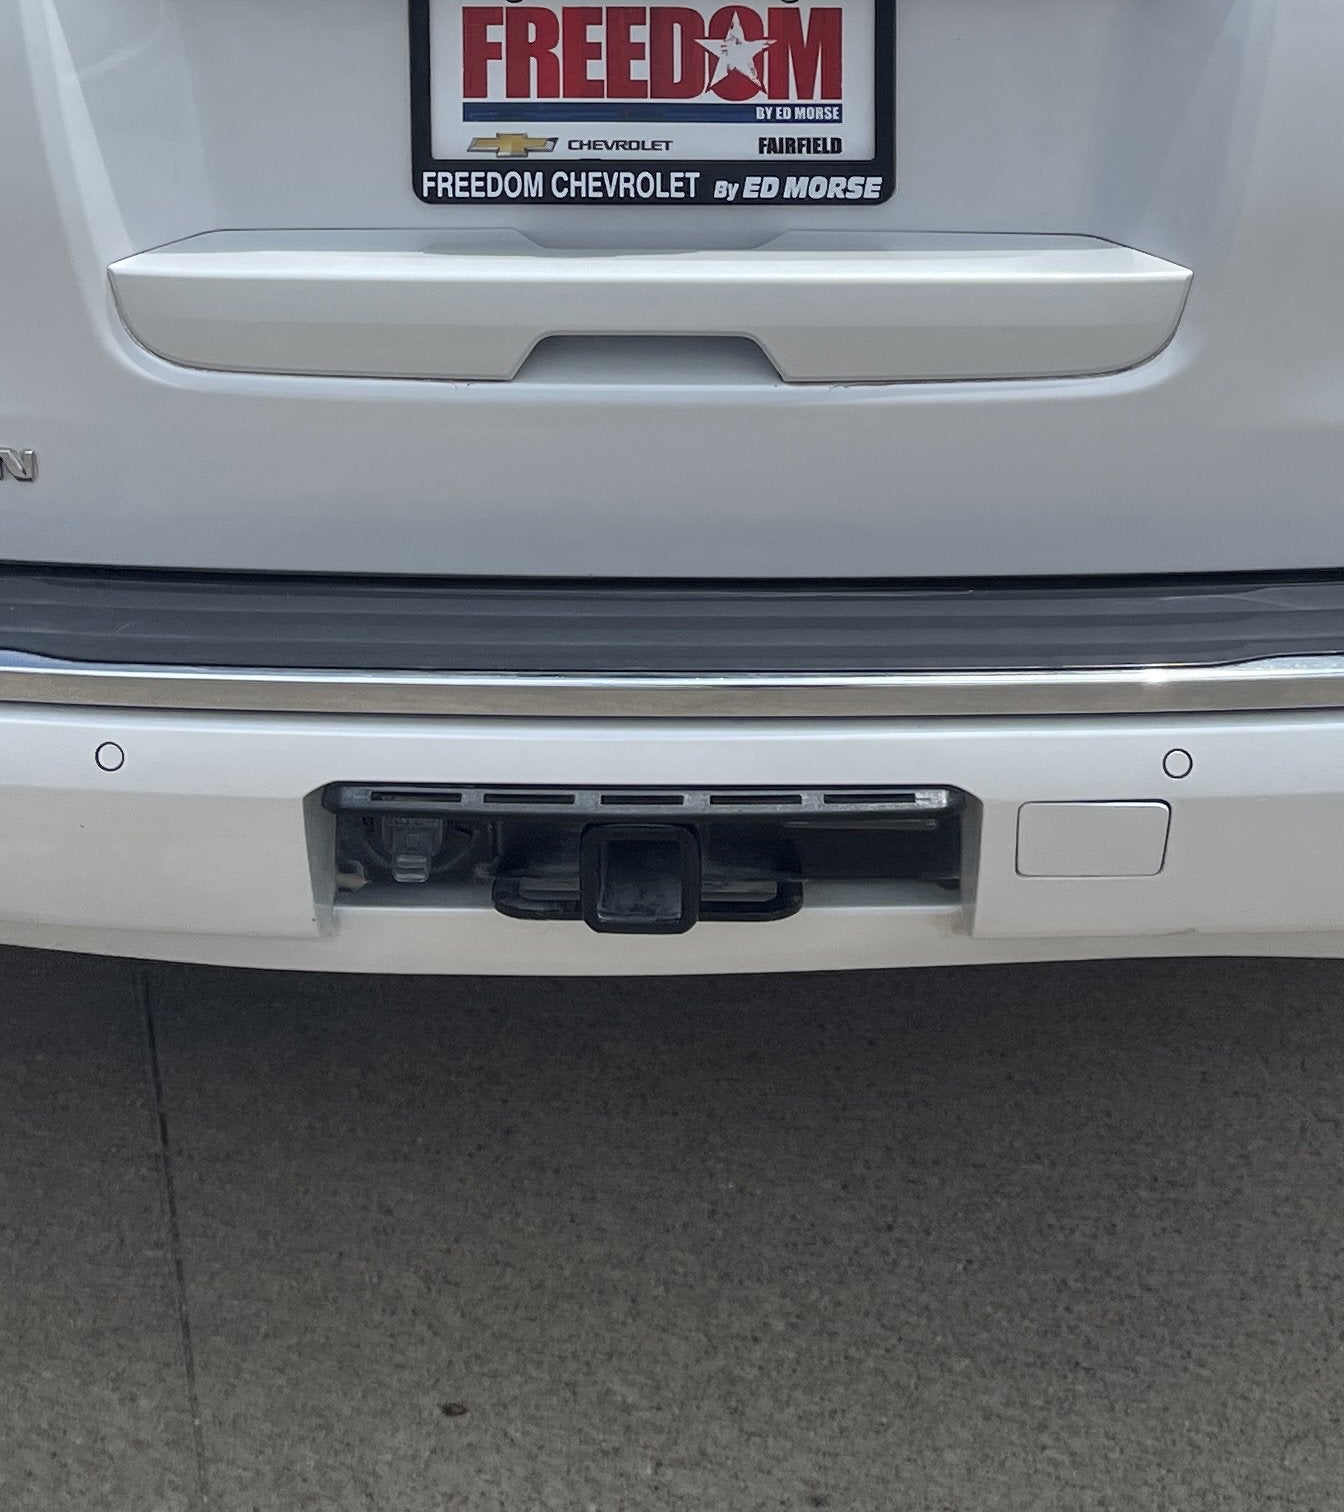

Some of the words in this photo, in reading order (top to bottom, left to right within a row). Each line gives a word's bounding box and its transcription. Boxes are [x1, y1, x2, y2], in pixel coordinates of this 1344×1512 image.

[461, 4, 843, 102] FREEDOM
[757, 106, 774, 121] BY
[776, 106, 792, 121] ED
[794, 106, 840, 121] MORSE
[567, 139, 674, 152] CHEVROLET
[758, 136, 843, 156] FAIRFIELD
[421, 171, 544, 200] FREEDOM
[551, 171, 701, 200] CHEVROLET
[713, 179, 740, 202] By
[742, 176, 780, 200] ED
[782, 176, 883, 200] MORSE
